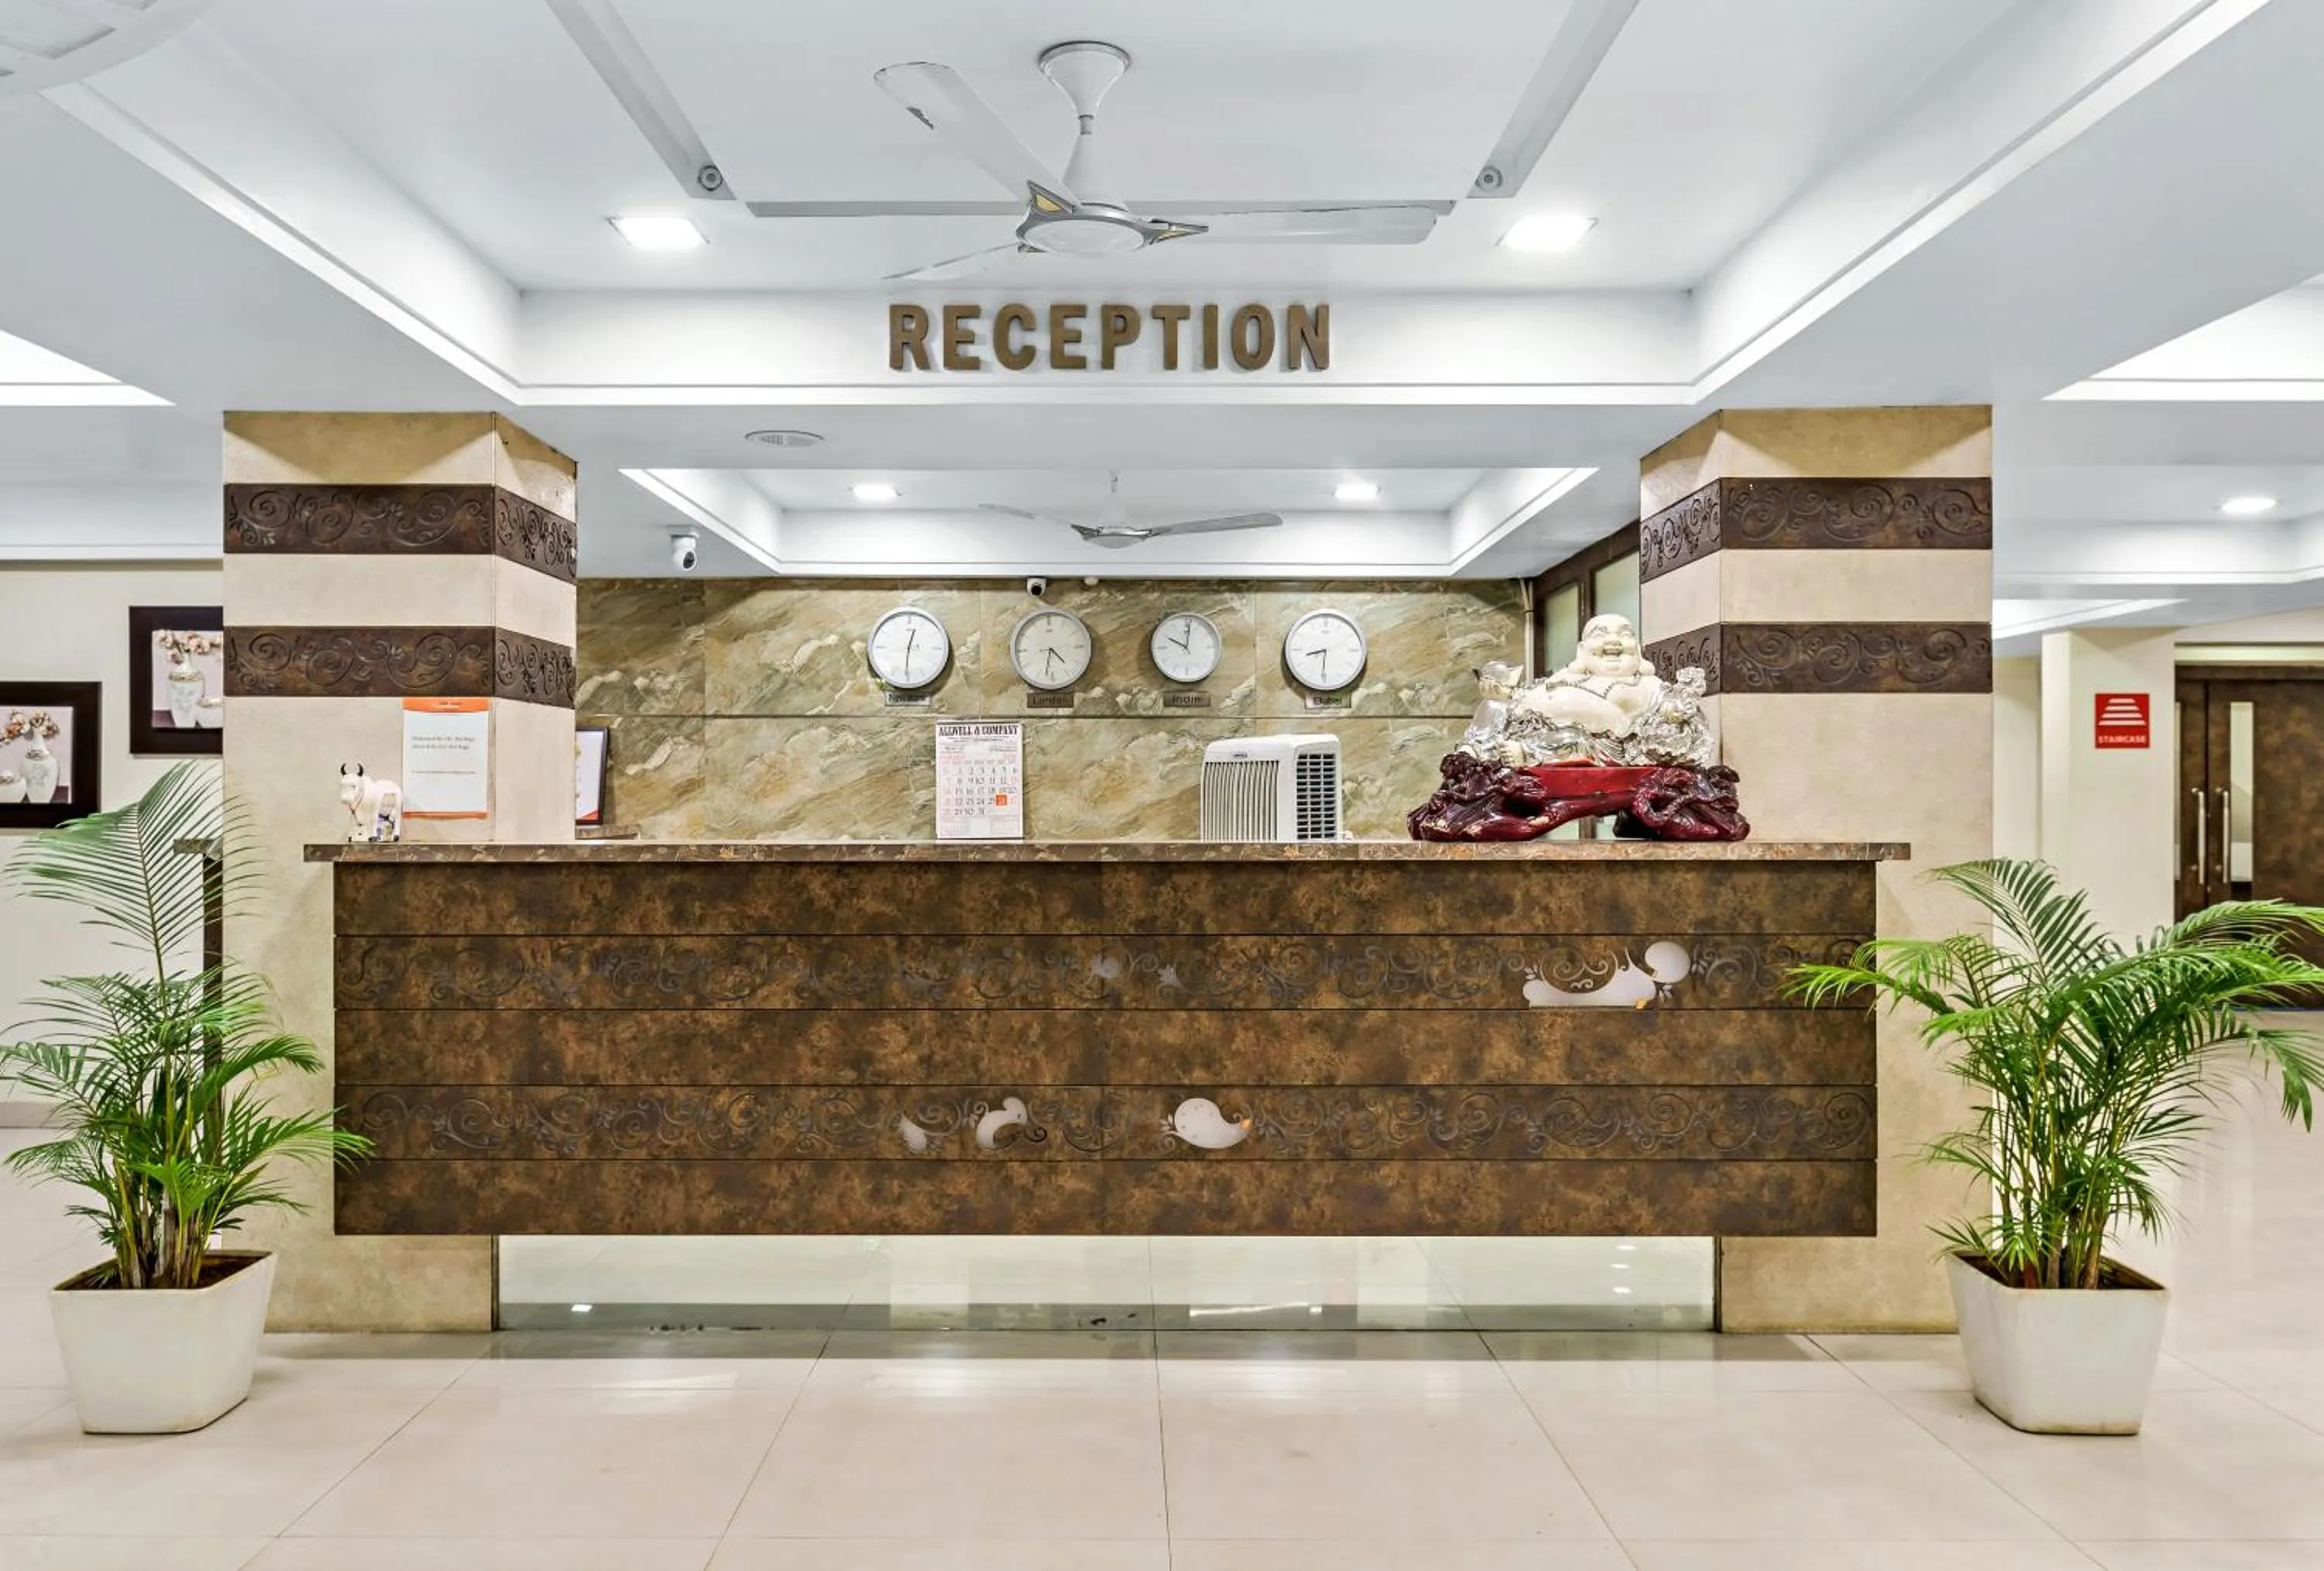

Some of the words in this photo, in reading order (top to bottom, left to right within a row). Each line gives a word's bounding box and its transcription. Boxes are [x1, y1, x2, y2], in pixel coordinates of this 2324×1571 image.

[889, 304, 1330, 371] RECEPTION
[1033, 696, 1068, 705] London
[982, 725, 1019, 735] COMPANY
[2098, 735, 2147, 744] STAIRCASE
